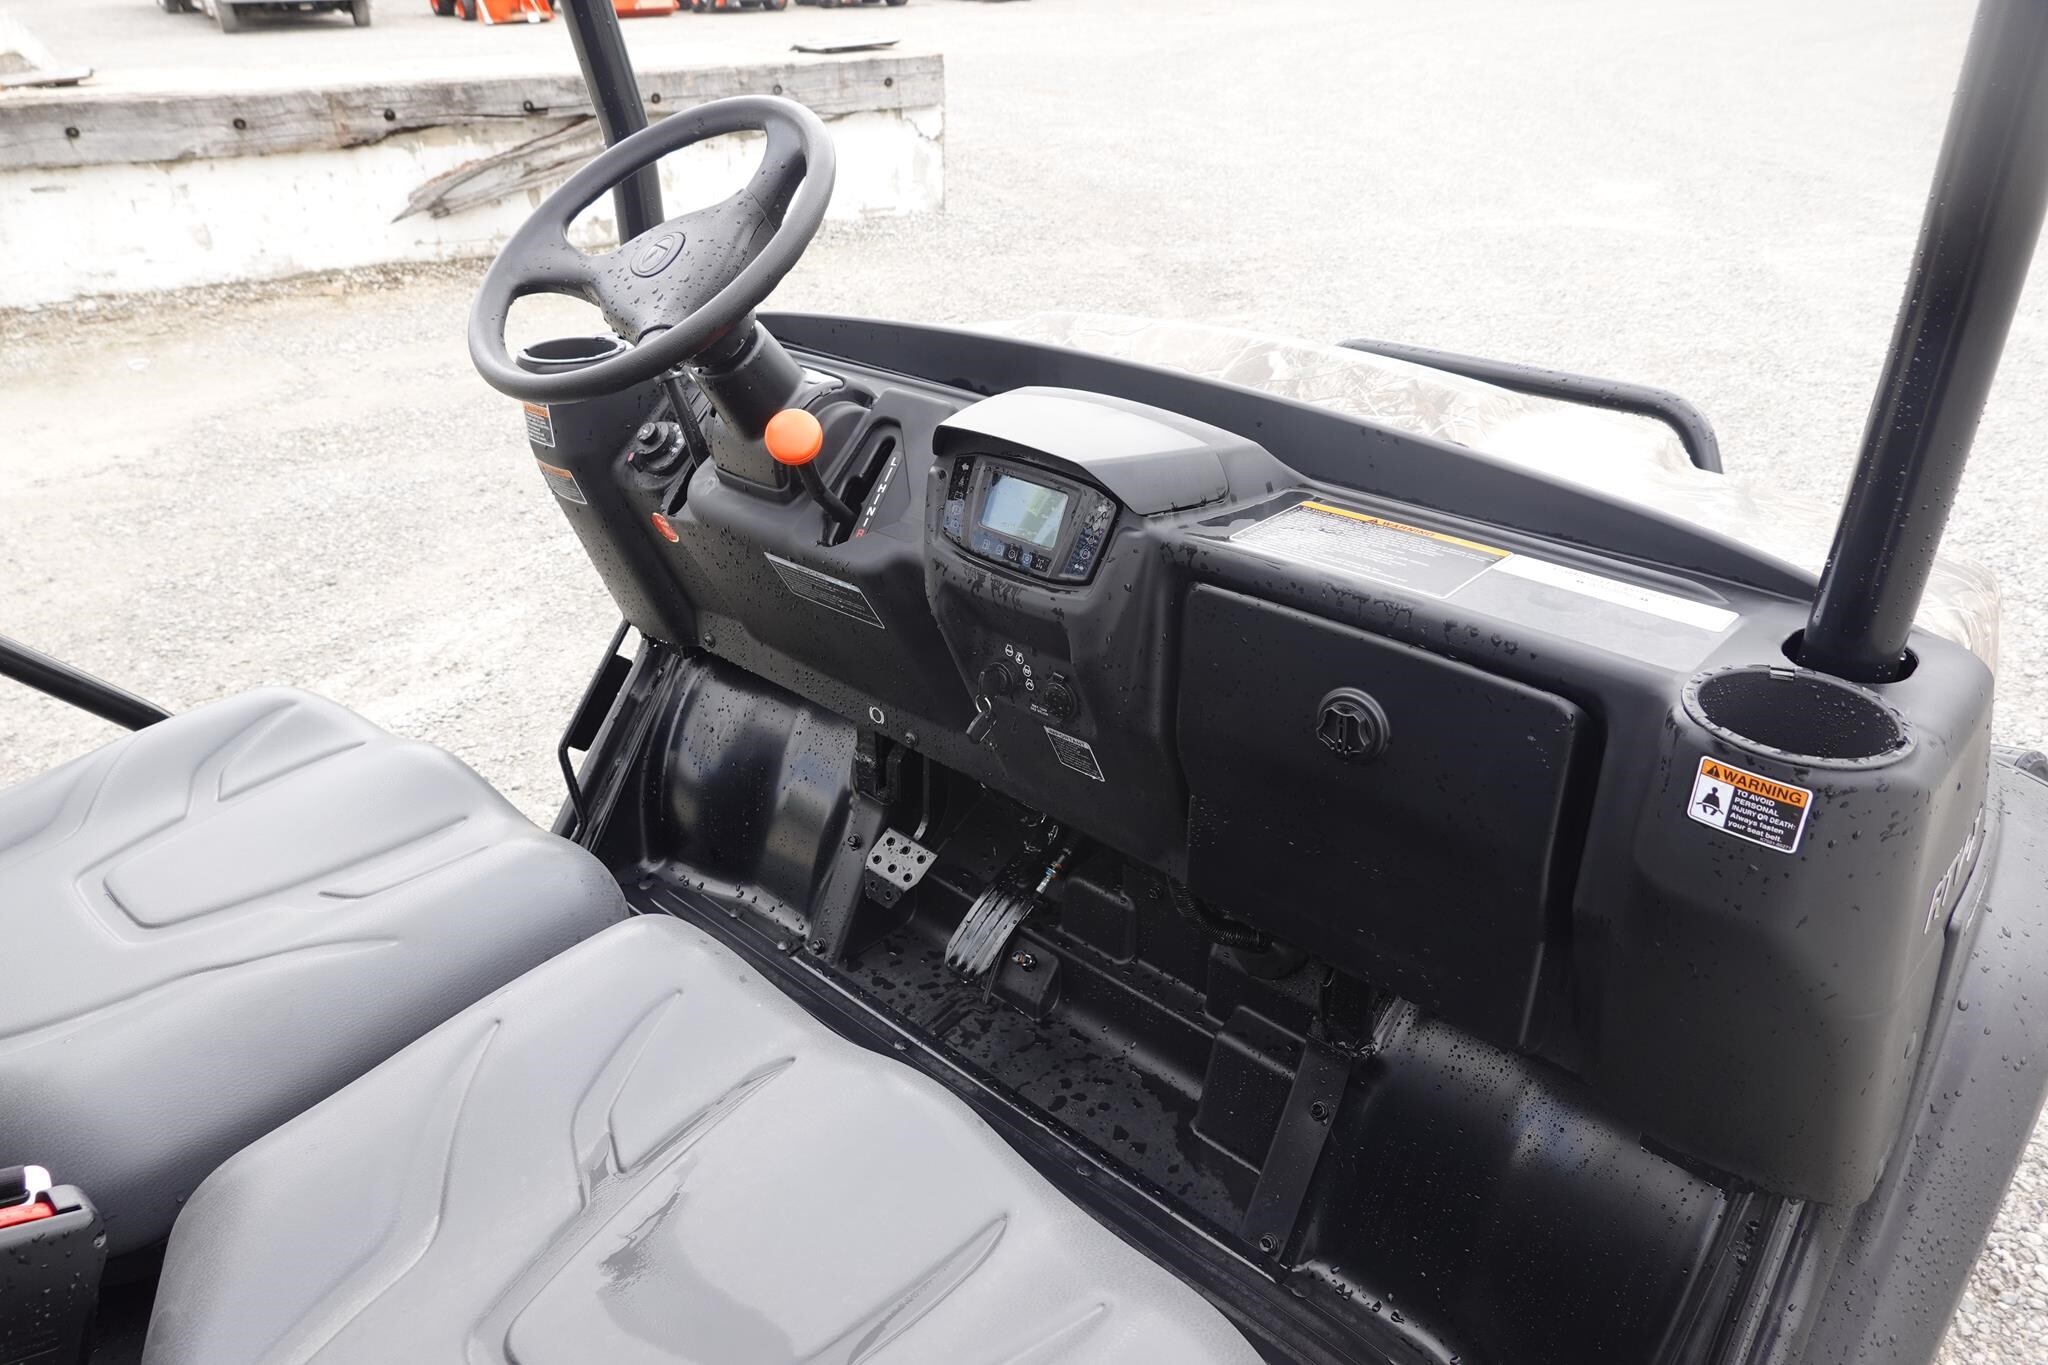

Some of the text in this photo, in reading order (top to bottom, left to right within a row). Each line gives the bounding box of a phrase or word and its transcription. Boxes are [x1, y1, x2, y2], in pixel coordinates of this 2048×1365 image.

[890, 457, 897, 466] L
[877, 484, 887, 493] H
[866, 506, 876, 516] N
[855, 529, 865, 537] R
[1723, 769, 1802, 804] WARNING
[1737, 790, 1775, 807] TO AVOID
[1731, 805, 1757, 819] INJURY
[1757, 812, 1768, 821] OR
[1734, 797, 1779, 817] PERSONAL
[1727, 820, 1746, 831] your
[1746, 826, 1764, 837] seat
[1730, 813, 1784, 835] Always fasten
